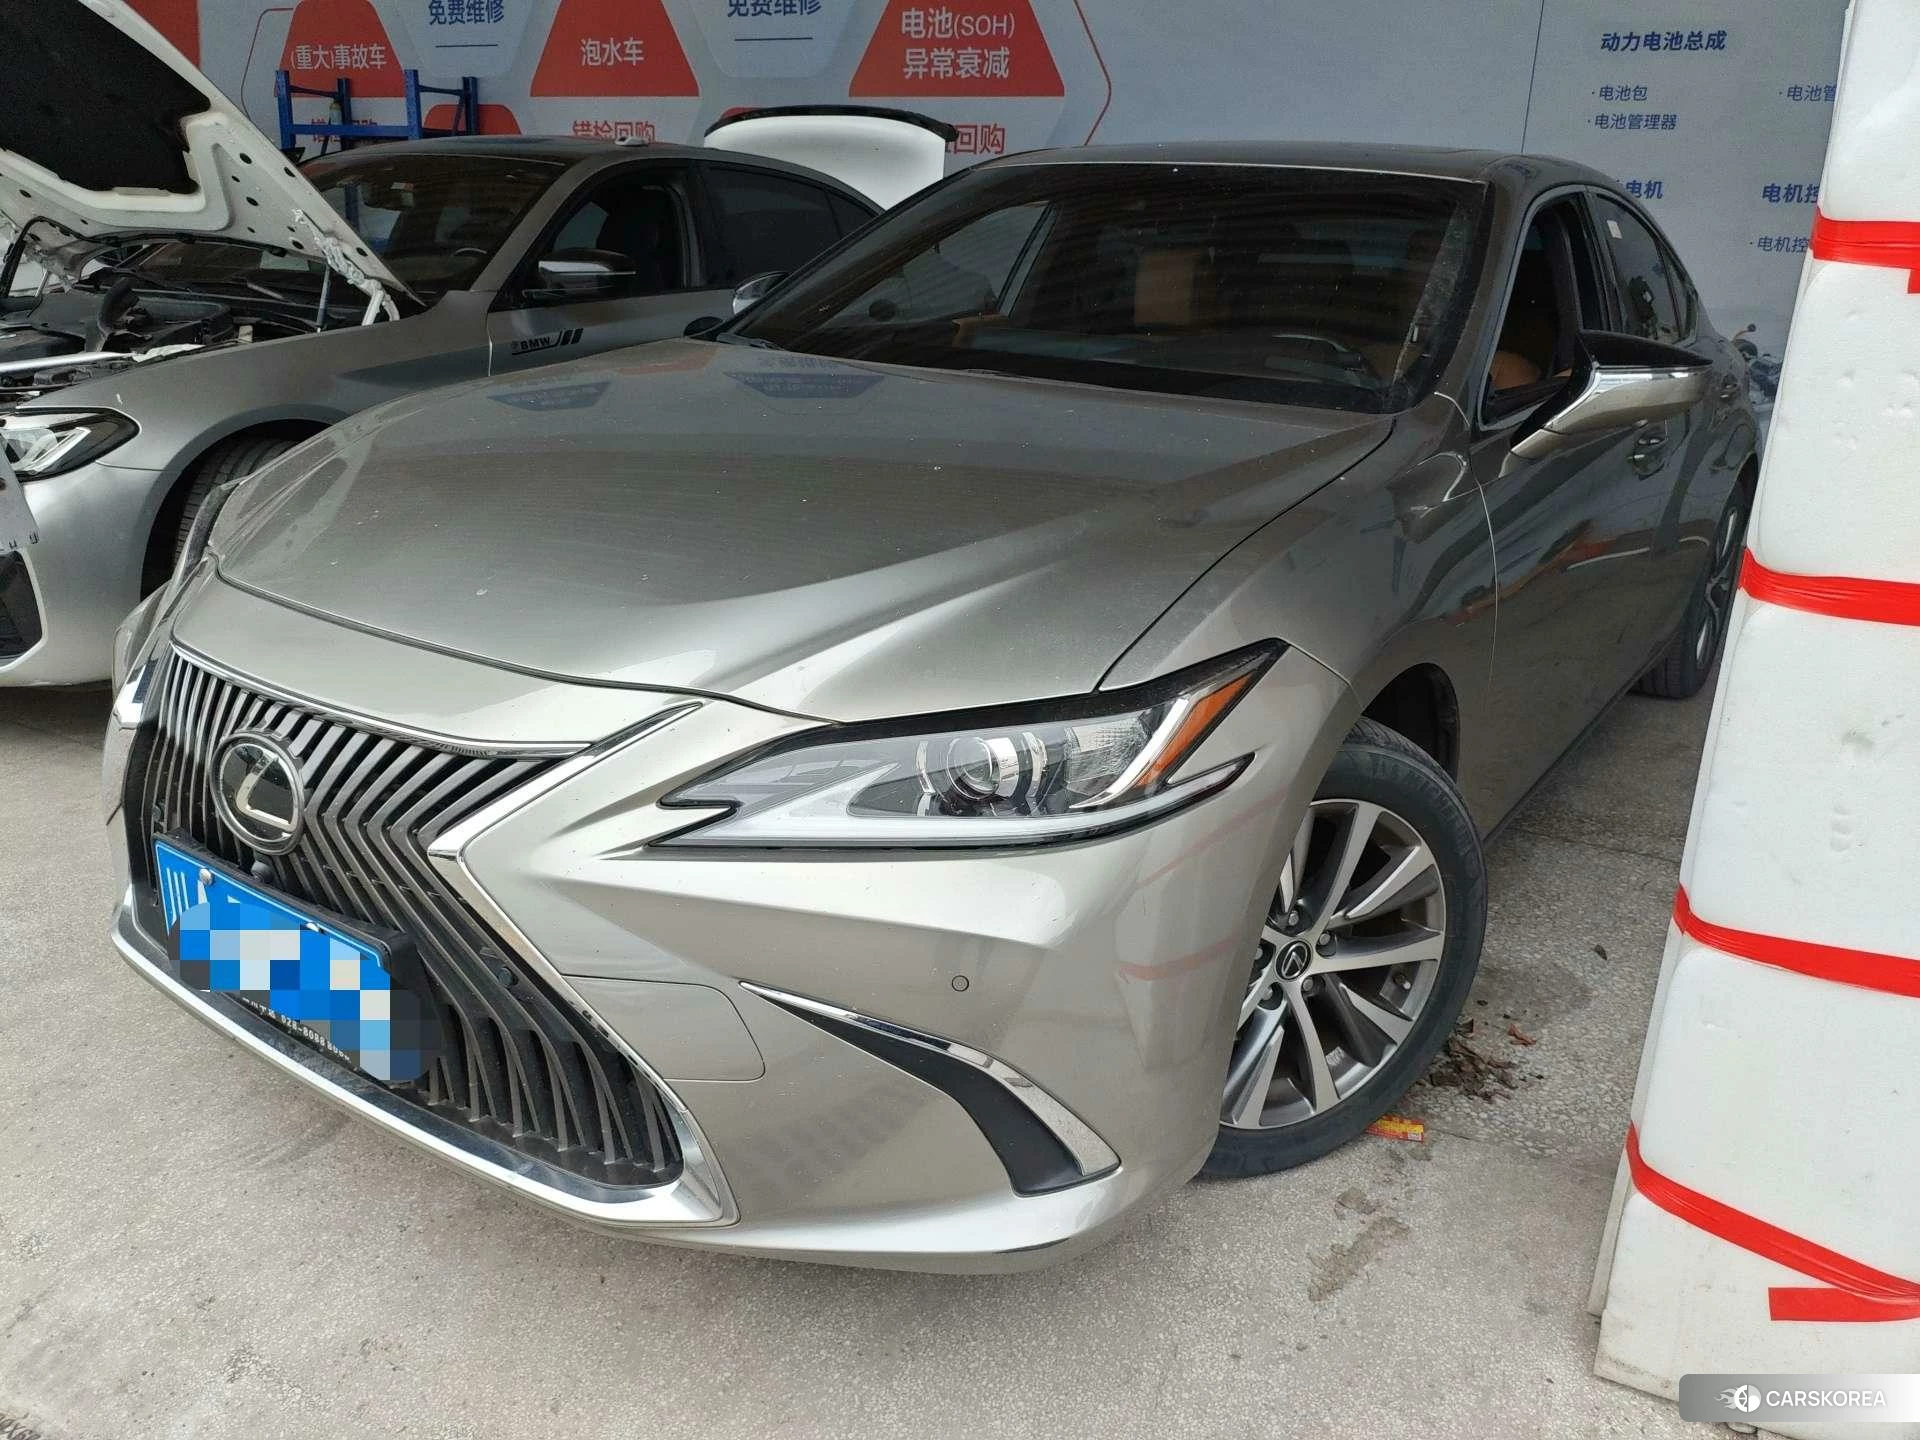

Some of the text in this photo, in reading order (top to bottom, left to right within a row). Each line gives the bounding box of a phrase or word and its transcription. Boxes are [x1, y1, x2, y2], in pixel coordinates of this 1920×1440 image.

[901, 7, 1015, 41] 电池(SOH)
[580, 37, 645, 67] 泡水车
[1601, 30, 1728, 52] 动力电池总成
[903, 47, 1010, 81] 异常衰减
[1598, 84, 1648, 102] 电池包
[1594, 113, 1677, 131] 电池管理器
[520, 336, 551, 351] BMW
